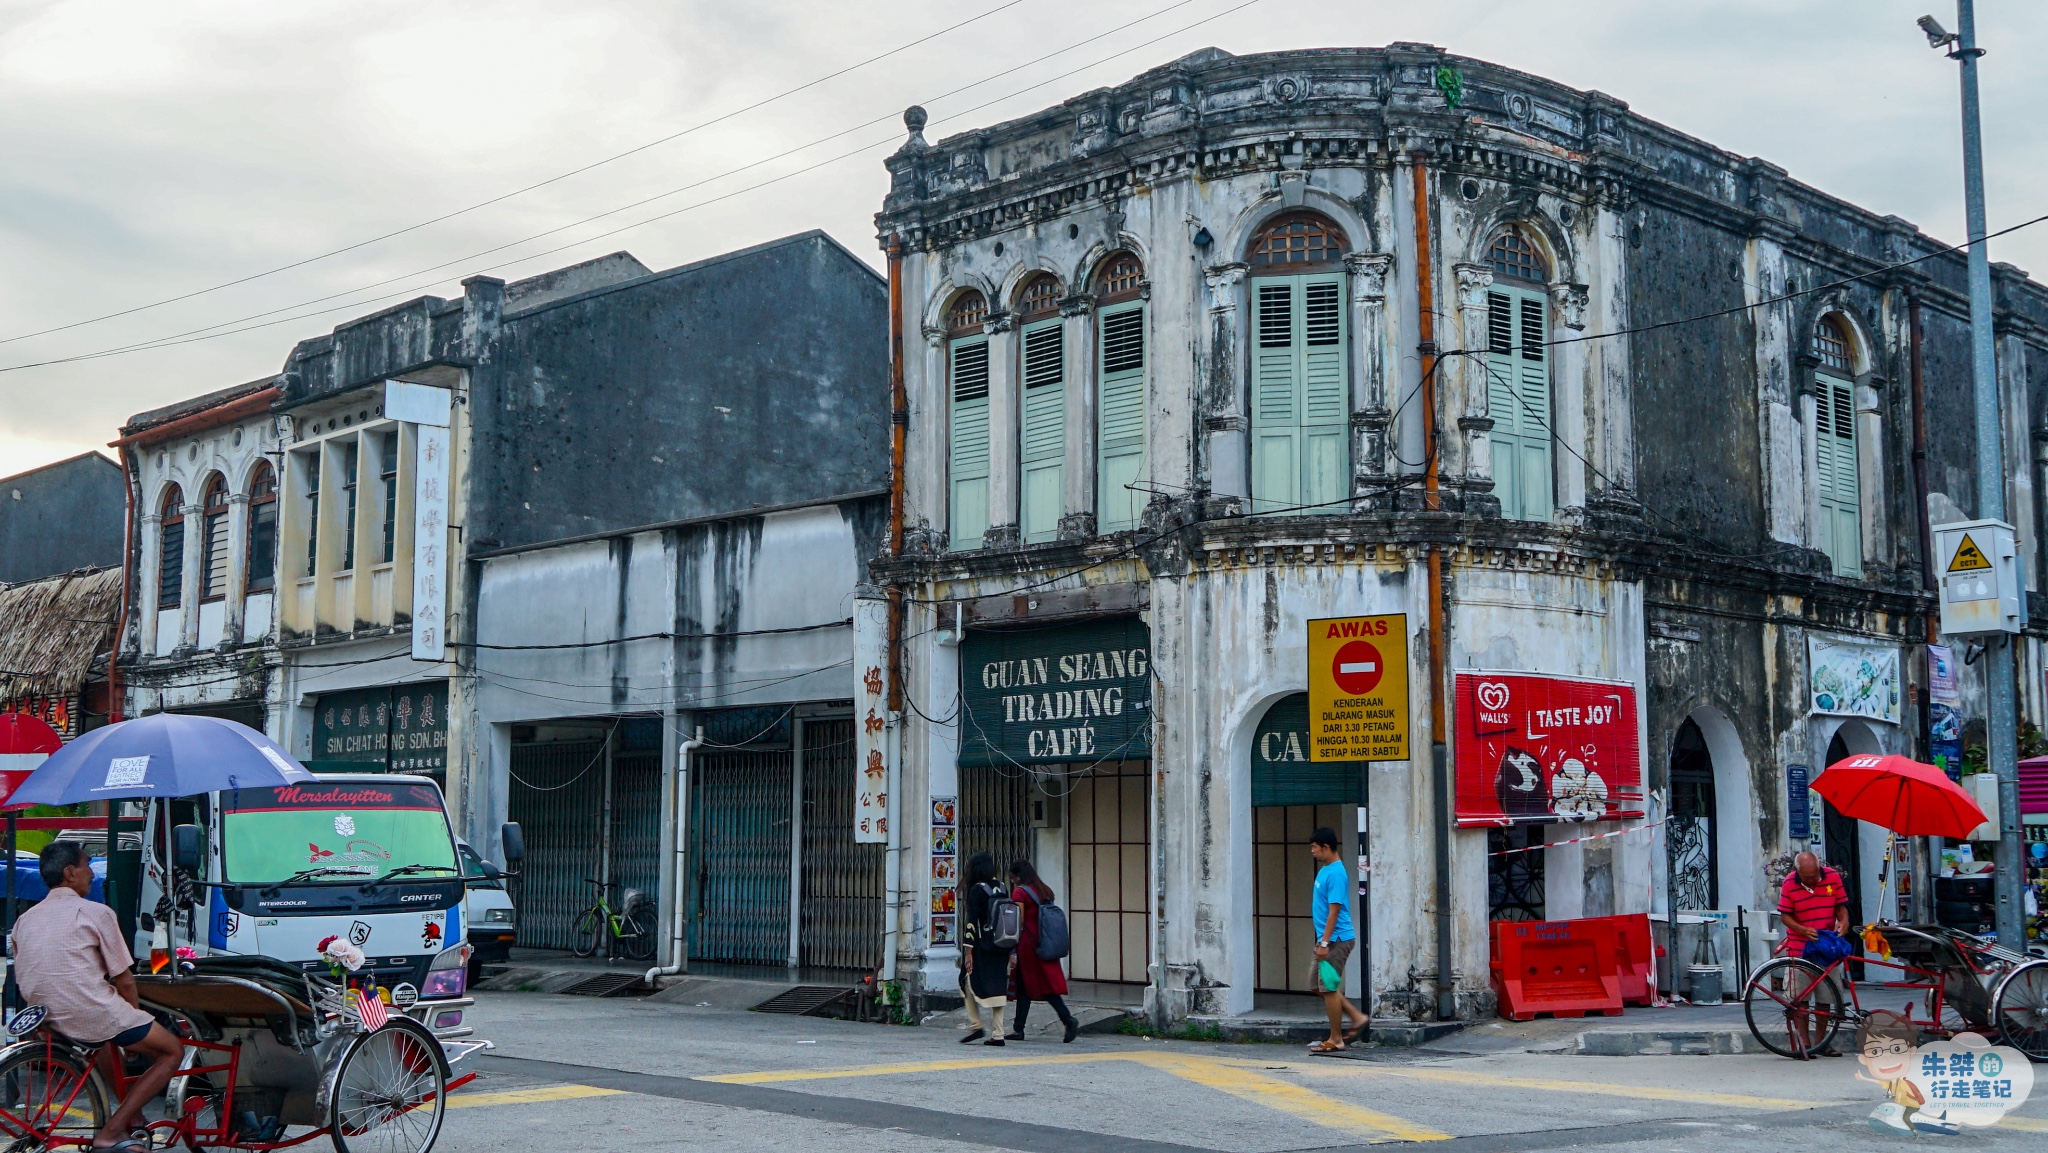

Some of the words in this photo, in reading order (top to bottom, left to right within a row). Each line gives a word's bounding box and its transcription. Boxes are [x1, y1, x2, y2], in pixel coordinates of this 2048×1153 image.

[1326, 620, 1388, 639] AWAS
[982, 657, 1049, 689] GUAN
[1059, 648, 1148, 683] SEANG
[1002, 686, 1124, 722] TRADING
[1333, 697, 1383, 708] KENDERAAN
[1322, 711, 1363, 721] DILARANG
[1366, 709, 1395, 719] MASUK
[1480, 712, 1509, 724] WALL'S
[1536, 707, 1581, 728] TASTE
[1584, 705, 1613, 725] JOY
[1323, 724, 1343, 733] DARI
[1345, 723, 1360, 732] 3.30
[1363, 722, 1395, 731] PETANG
[327, 737, 343, 753] SIN
[346, 734, 373, 752] CHIAT
[409, 731, 432, 749] SDN.
[433, 730, 448, 748] BH
[1028, 719, 1095, 757] CAFÉ
[1316, 736, 1348, 746] HINGGA
[1350, 735, 1370, 744] 10.30
[1372, 734, 1402, 743] MALAM
[1260, 731, 1310, 762] CA
[1320, 748, 1348, 758] SETIAP
[1350, 747, 1370, 757] HARI
[1372, 746, 1400, 756] SABTU
[114, 759, 145, 768] LOVE
[273, 786, 393, 805] Mersalayitten
[400, 893, 442, 902] CANTER
[302, 958, 407, 970] FSO
